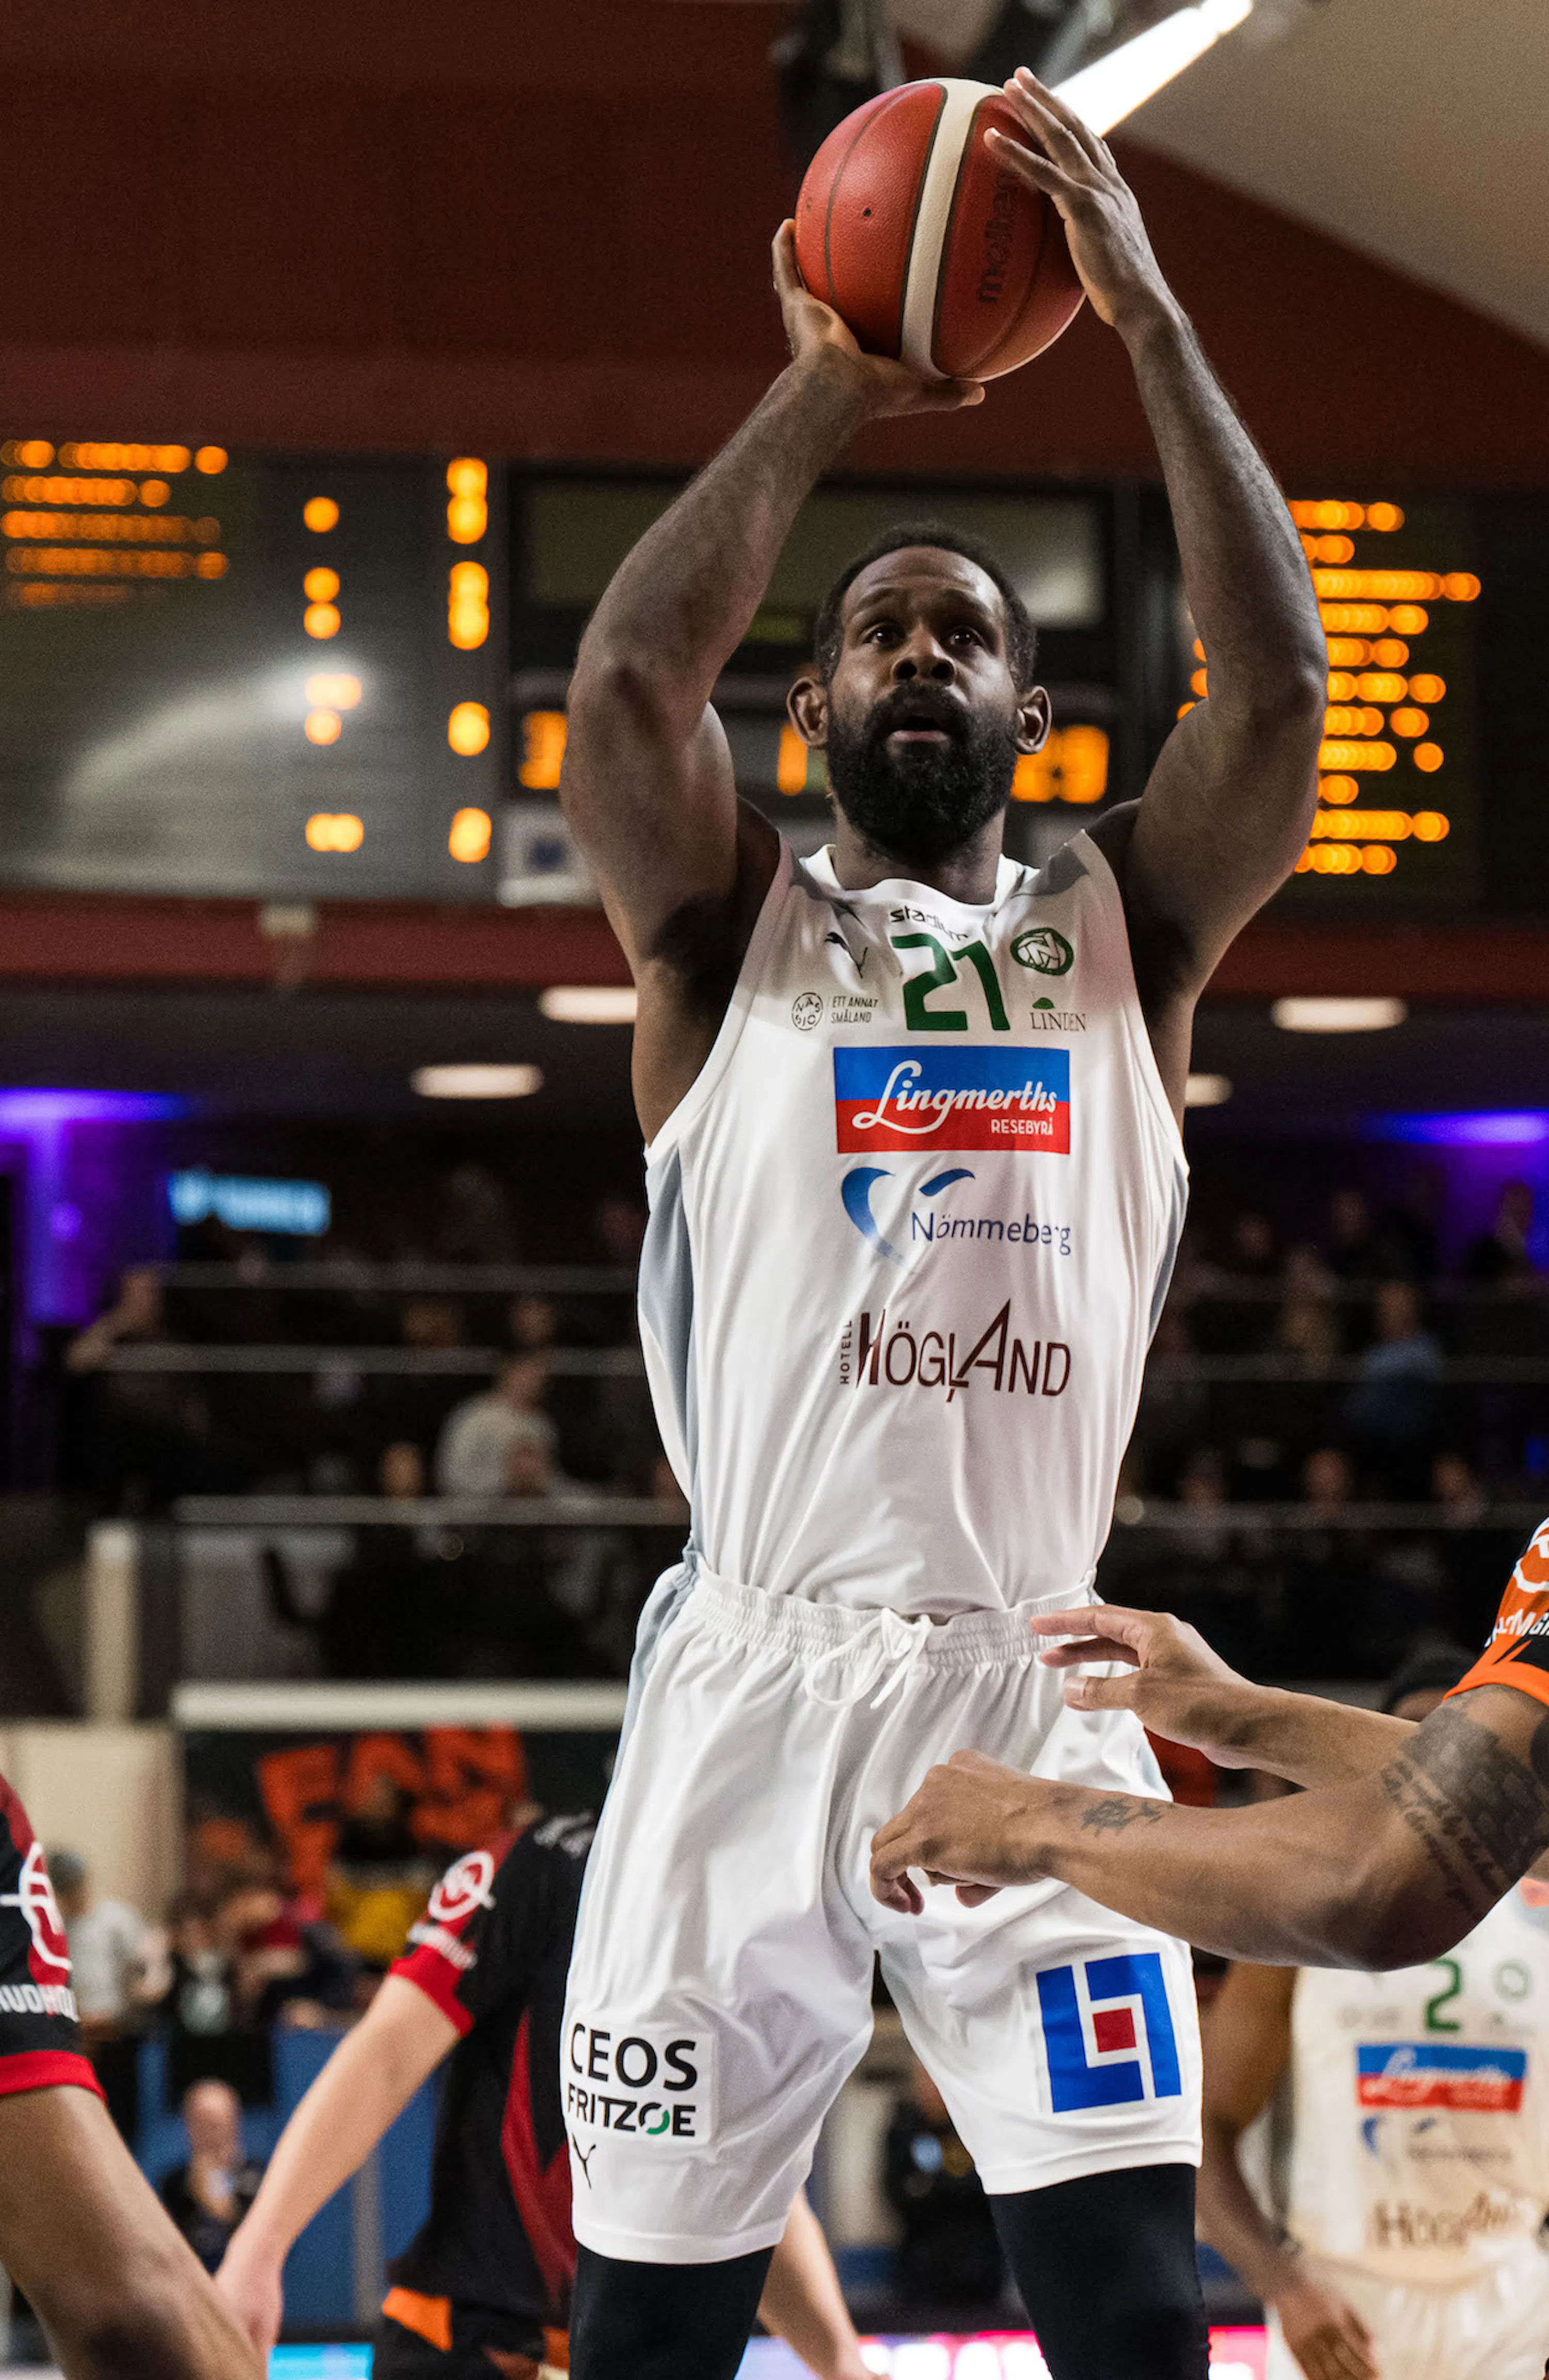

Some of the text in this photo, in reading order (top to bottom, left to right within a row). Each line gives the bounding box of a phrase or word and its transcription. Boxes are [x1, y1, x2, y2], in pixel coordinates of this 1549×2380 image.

[833, 996, 878, 1008] ETT ANNAT
[891, 933, 1010, 1031] 21
[831, 1009, 872, 1024] SMÅLAND
[852, 1060, 1056, 1134] Lingmerths
[991, 1118, 1054, 1135] RESEBYRÅ
[912, 1212, 1071, 1256] Nömmebeg
[840, 1321, 852, 1385] HOTELL
[856, 1298, 1071, 1403] HÖGLAND
[1425, 1958, 1462, 2032] 2
[571, 2023, 698, 2091] CEOS
[568, 2082, 696, 2137] FRITZOE
